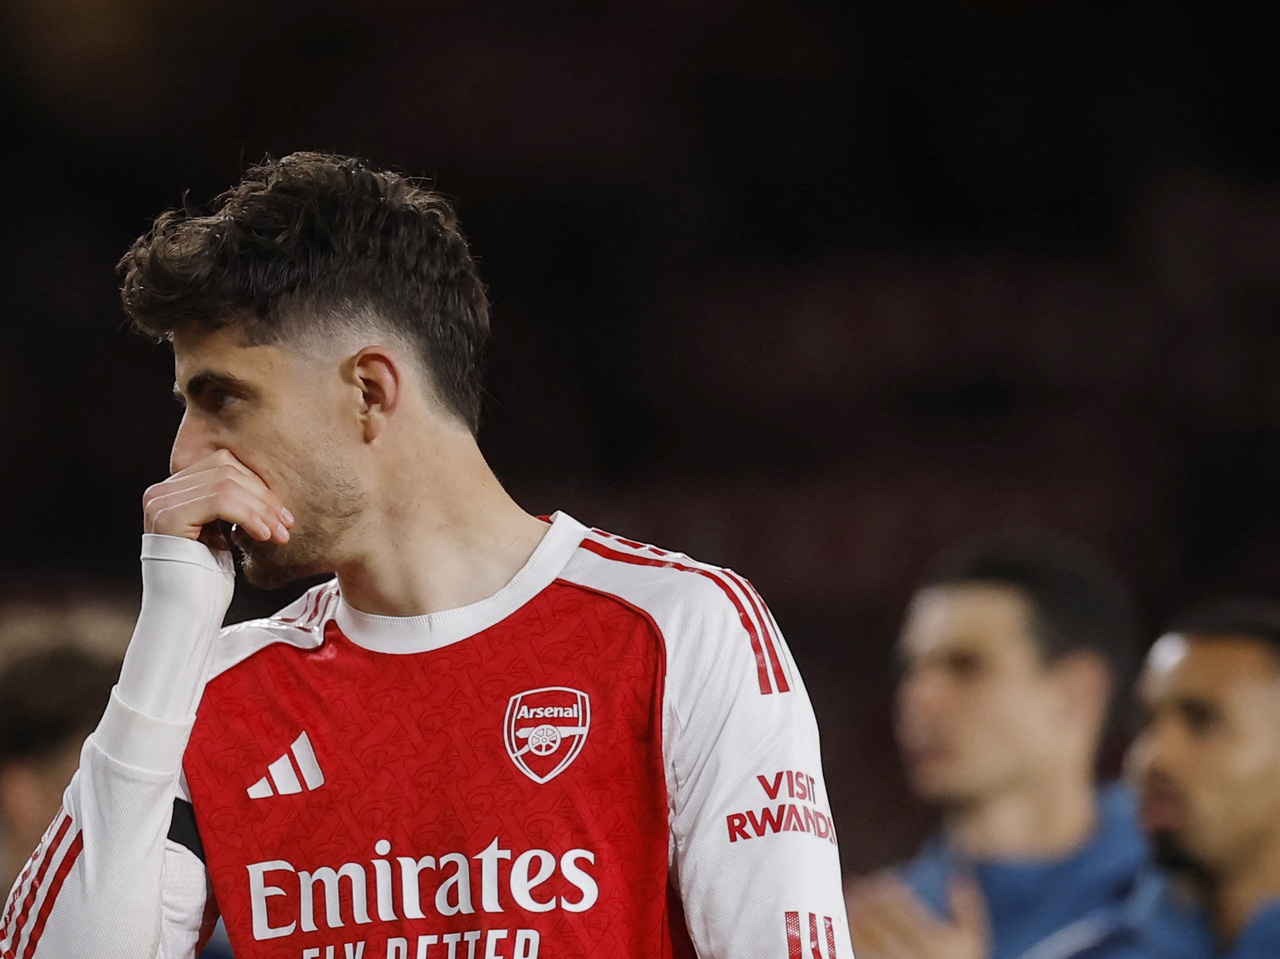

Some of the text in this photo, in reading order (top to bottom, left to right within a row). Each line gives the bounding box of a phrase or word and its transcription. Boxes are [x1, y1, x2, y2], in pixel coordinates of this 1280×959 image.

[516, 703, 578, 719] Arsenal
[756, 770, 816, 804] VISIT
[245, 836, 599, 941] Emirates
